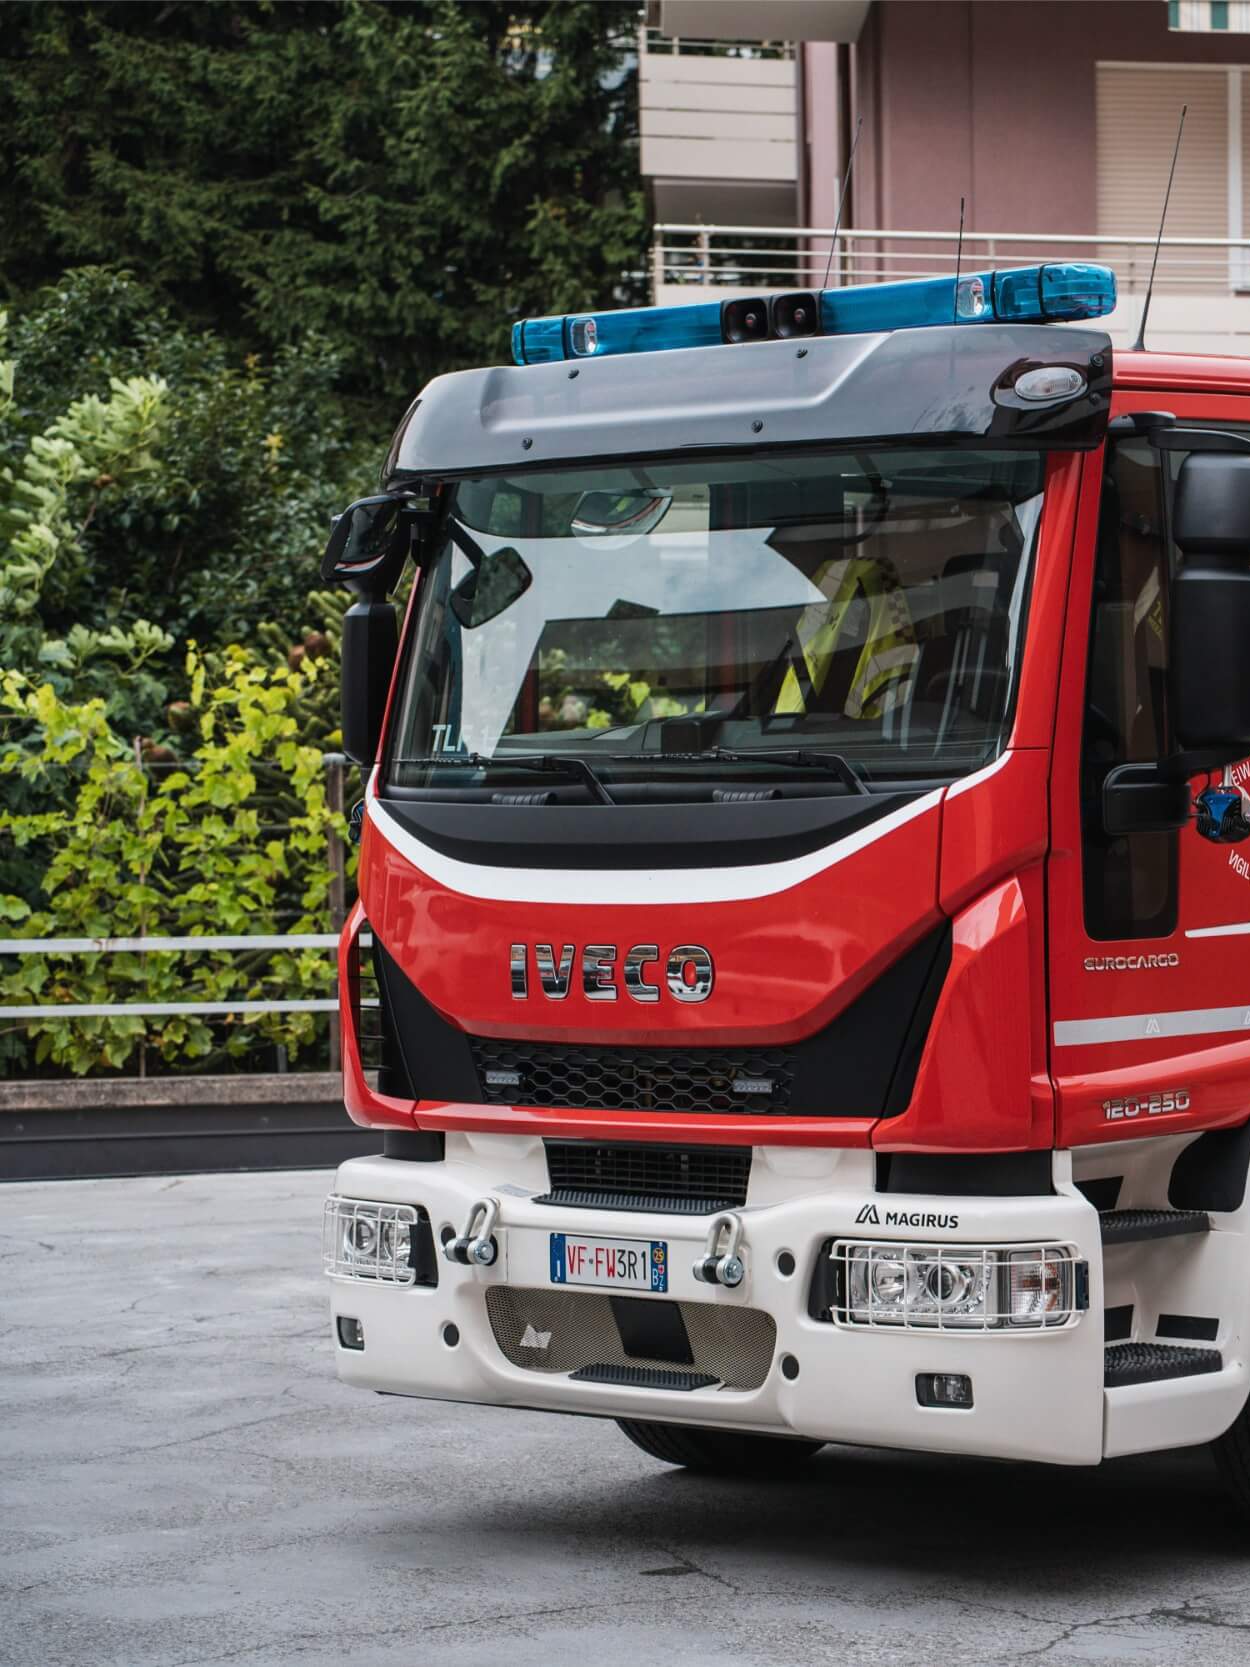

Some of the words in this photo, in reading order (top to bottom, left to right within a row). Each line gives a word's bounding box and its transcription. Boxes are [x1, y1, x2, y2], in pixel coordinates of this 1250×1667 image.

[1084, 953, 1179, 971] EUROCARGO
[510, 944, 715, 1003] IVECO
[885, 1212, 959, 1229] MAGIRUS
